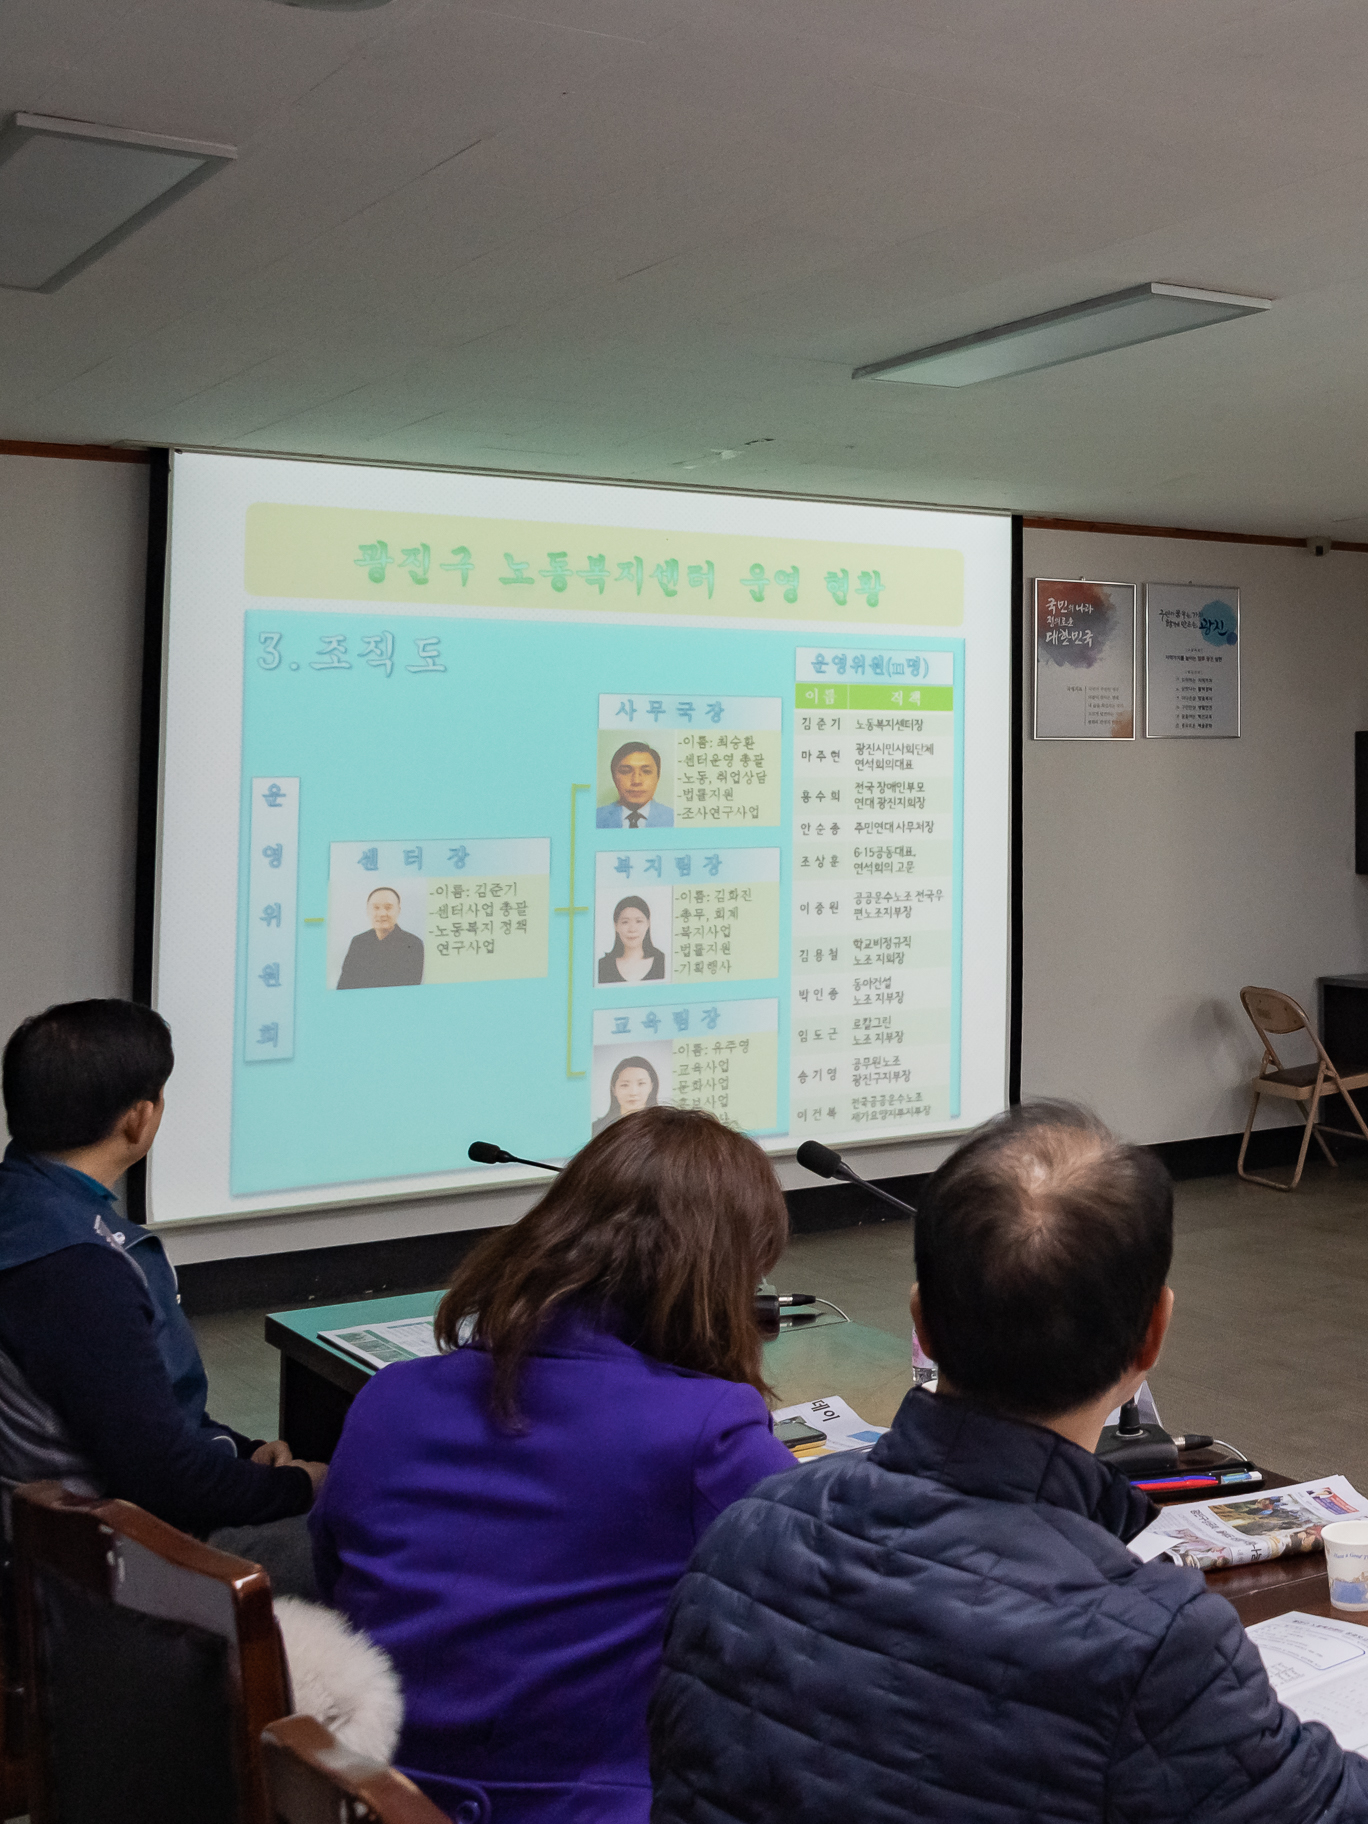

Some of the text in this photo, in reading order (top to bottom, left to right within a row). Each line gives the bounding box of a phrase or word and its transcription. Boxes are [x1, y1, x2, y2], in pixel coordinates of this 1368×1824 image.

[354, 540, 886, 608] 광진구 노동복지센터 운영 현황
[1075, 603, 1094, 614] 나라
[1199, 618, 1228, 636] 광진
[1045, 628, 1094, 648] 대한민국
[855, 718, 924, 732] 노동복지센터장
[855, 742, 935, 756] 광진시민사회단체
[854, 758, 914, 772] 연석회의대표
[716, 770, 768, 785] 취업상담
[854, 781, 926, 795] 전국 장애인부모
[854, 796, 926, 810] 연대 광진지회장
[854, 820, 934, 834] 주민연대 사무처장
[853, 860, 915, 875] 연석회의 고문
[474, 881, 518, 898] 김준기
[714, 887, 753, 903] 김화진
[853, 890, 914, 906] 공공운수노조
[499, 900, 529, 918] 총괄
[714, 906, 739, 921] 회계
[853, 906, 912, 921] 편노조지부장
[499, 919, 527, 935] 정책
[436, 938, 495, 956] 연구사업
[852, 935, 912, 951] 학교비정규직
[852, 951, 905, 966] 노조 지회장
[852, 976, 892, 991] 동아건설
[852, 991, 904, 1006] 노조 지부장
[851, 1030, 904, 1046] 노조 지부장
[851, 1055, 902, 1071] 공무원노조
[851, 1069, 911, 1087] 광진구지부장
